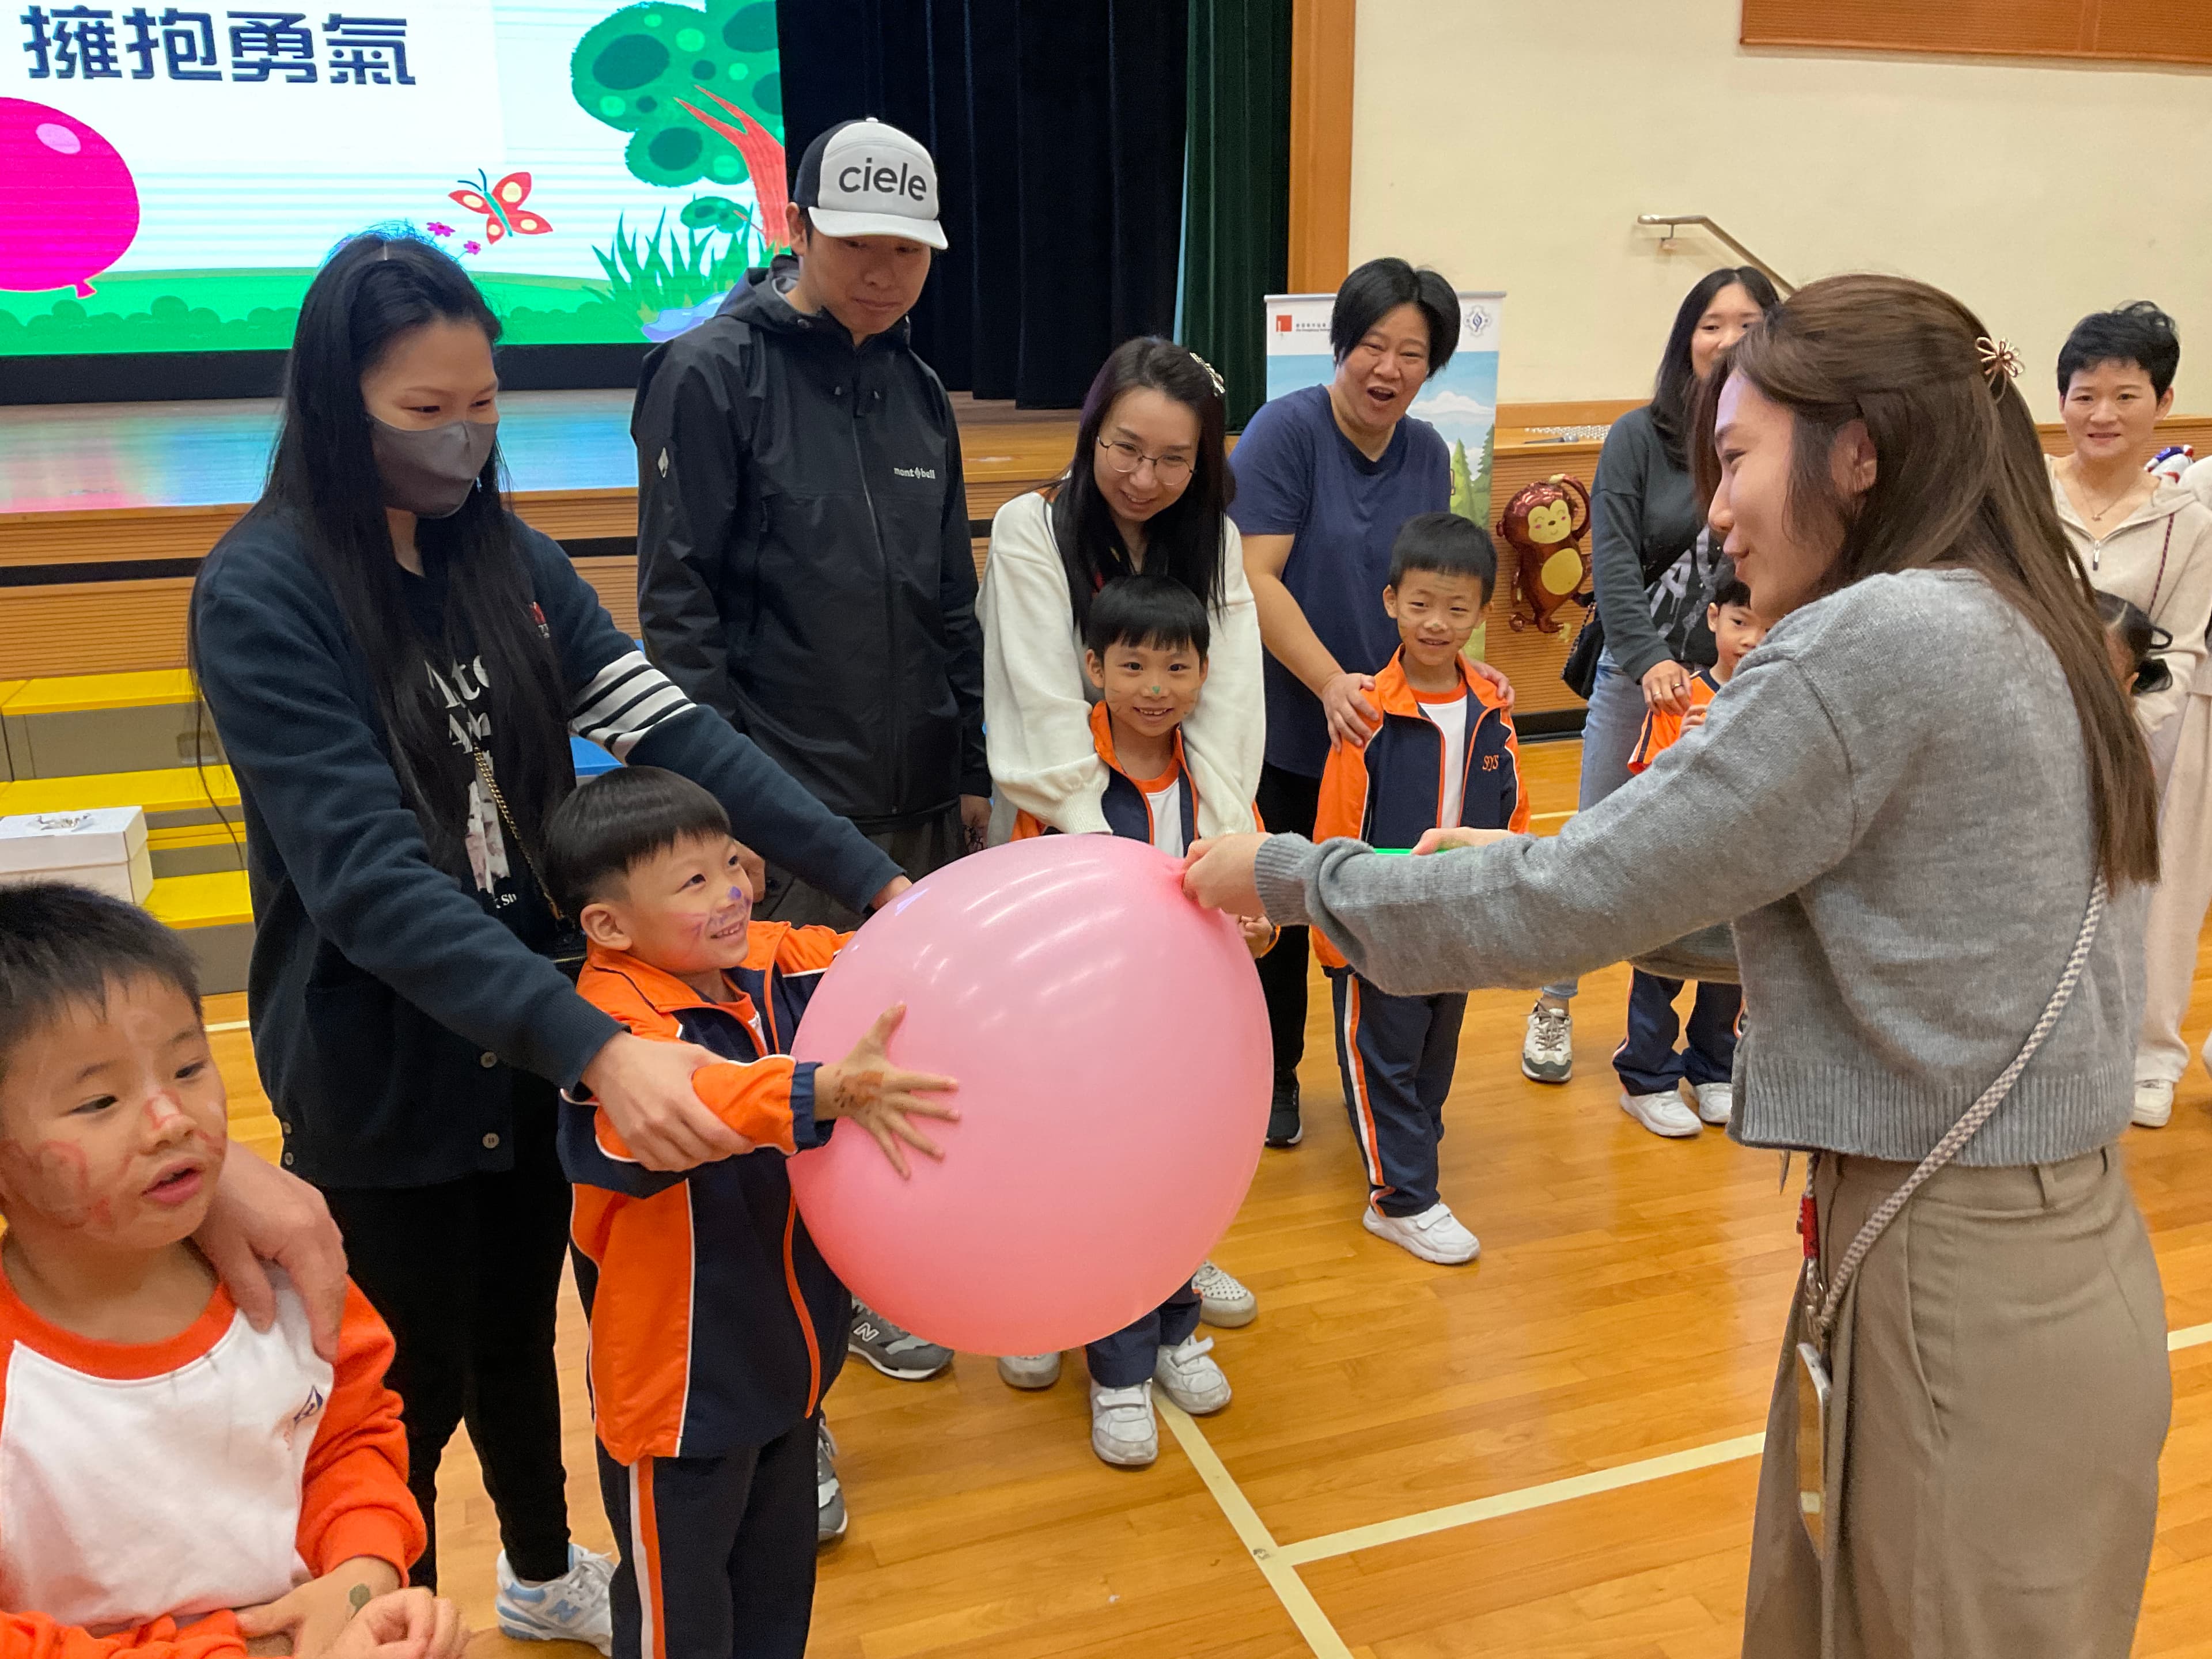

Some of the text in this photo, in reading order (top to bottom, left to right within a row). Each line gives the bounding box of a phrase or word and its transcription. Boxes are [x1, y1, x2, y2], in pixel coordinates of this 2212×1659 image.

[20, 5, 416, 85] 擁抱勇氣
[839, 157, 927, 201] ciele
[853, 1322, 880, 1342] N
[546, 1599, 581, 1623] N
